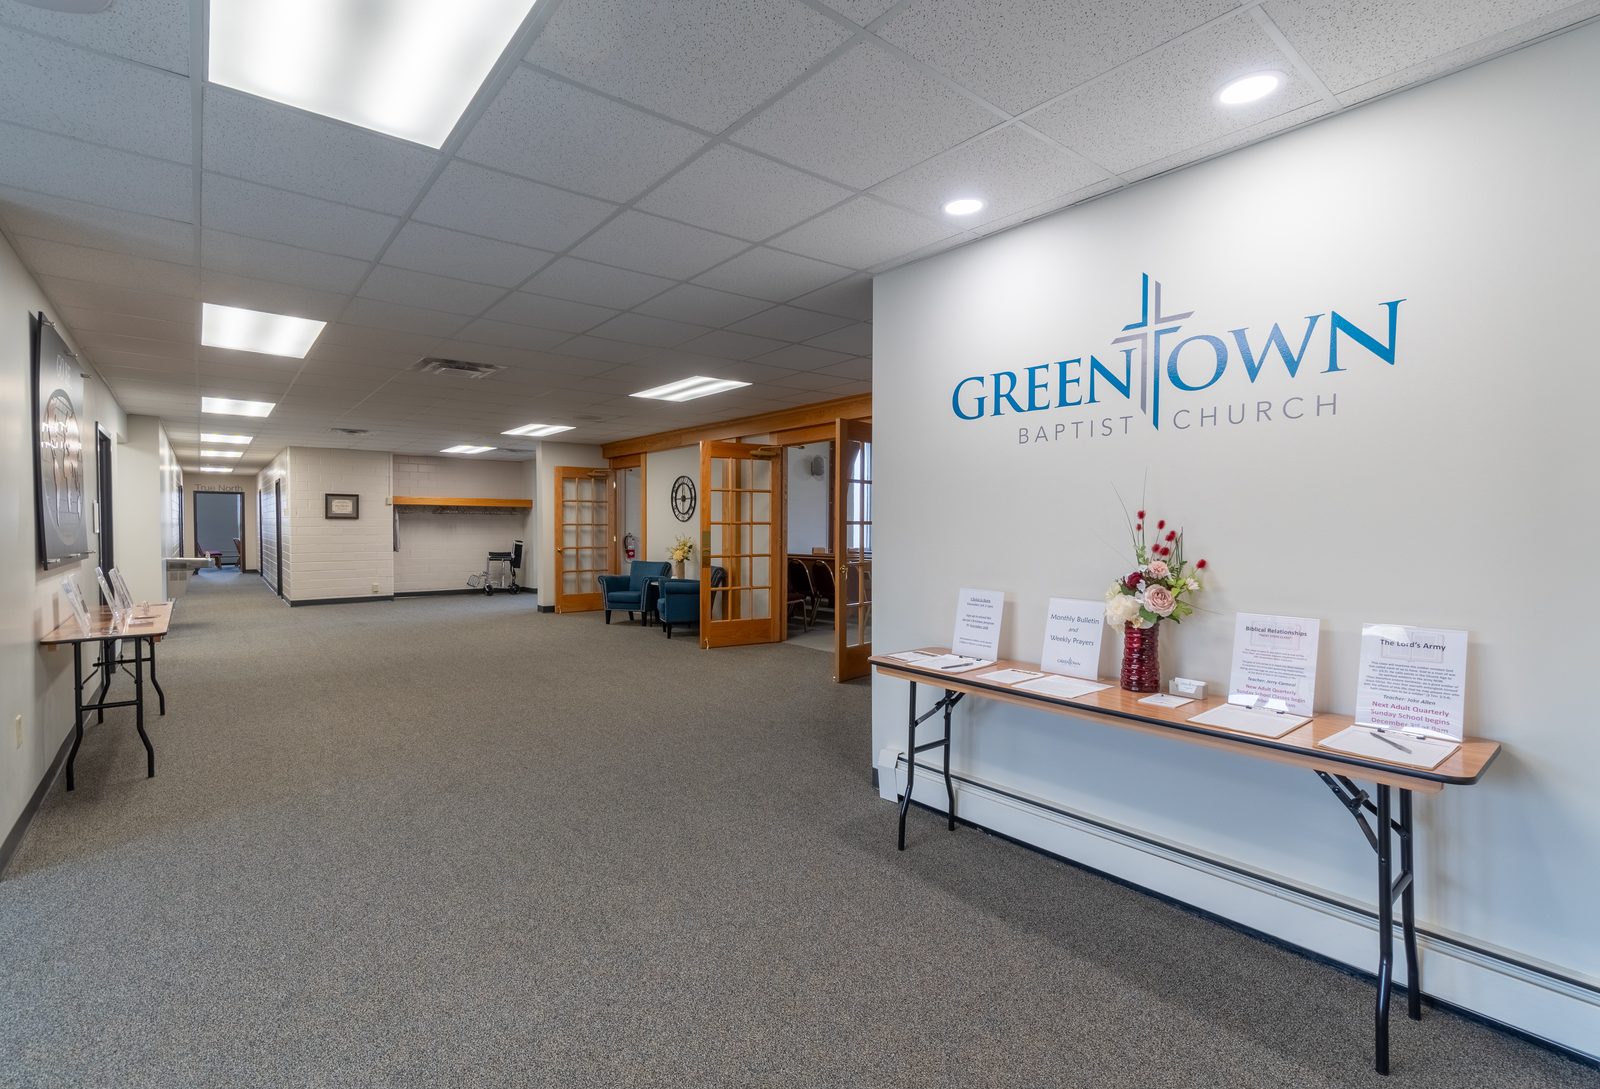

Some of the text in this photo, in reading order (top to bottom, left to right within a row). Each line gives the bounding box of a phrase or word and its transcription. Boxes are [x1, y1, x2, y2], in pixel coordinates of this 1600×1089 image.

[952, 272, 1407, 430] GREENTOWN
[1018, 393, 1337, 444] BAPTIST CHURCH
[218, 484, 243, 492] North
[1050, 613, 1100, 624] Monthly Bulletin
[1267, 628, 1308, 637] Relationships
[1050, 634, 1094, 647] Weekly Prayers
[1423, 643, 1447, 652] Army
[1272, 688, 1296, 696] Quarterly
[1390, 703, 1411, 712] Adult
[1412, 706, 1450, 718] Quarterly
[1370, 708, 1450, 726] Sunday School begins
[1371, 717, 1408, 728] December
